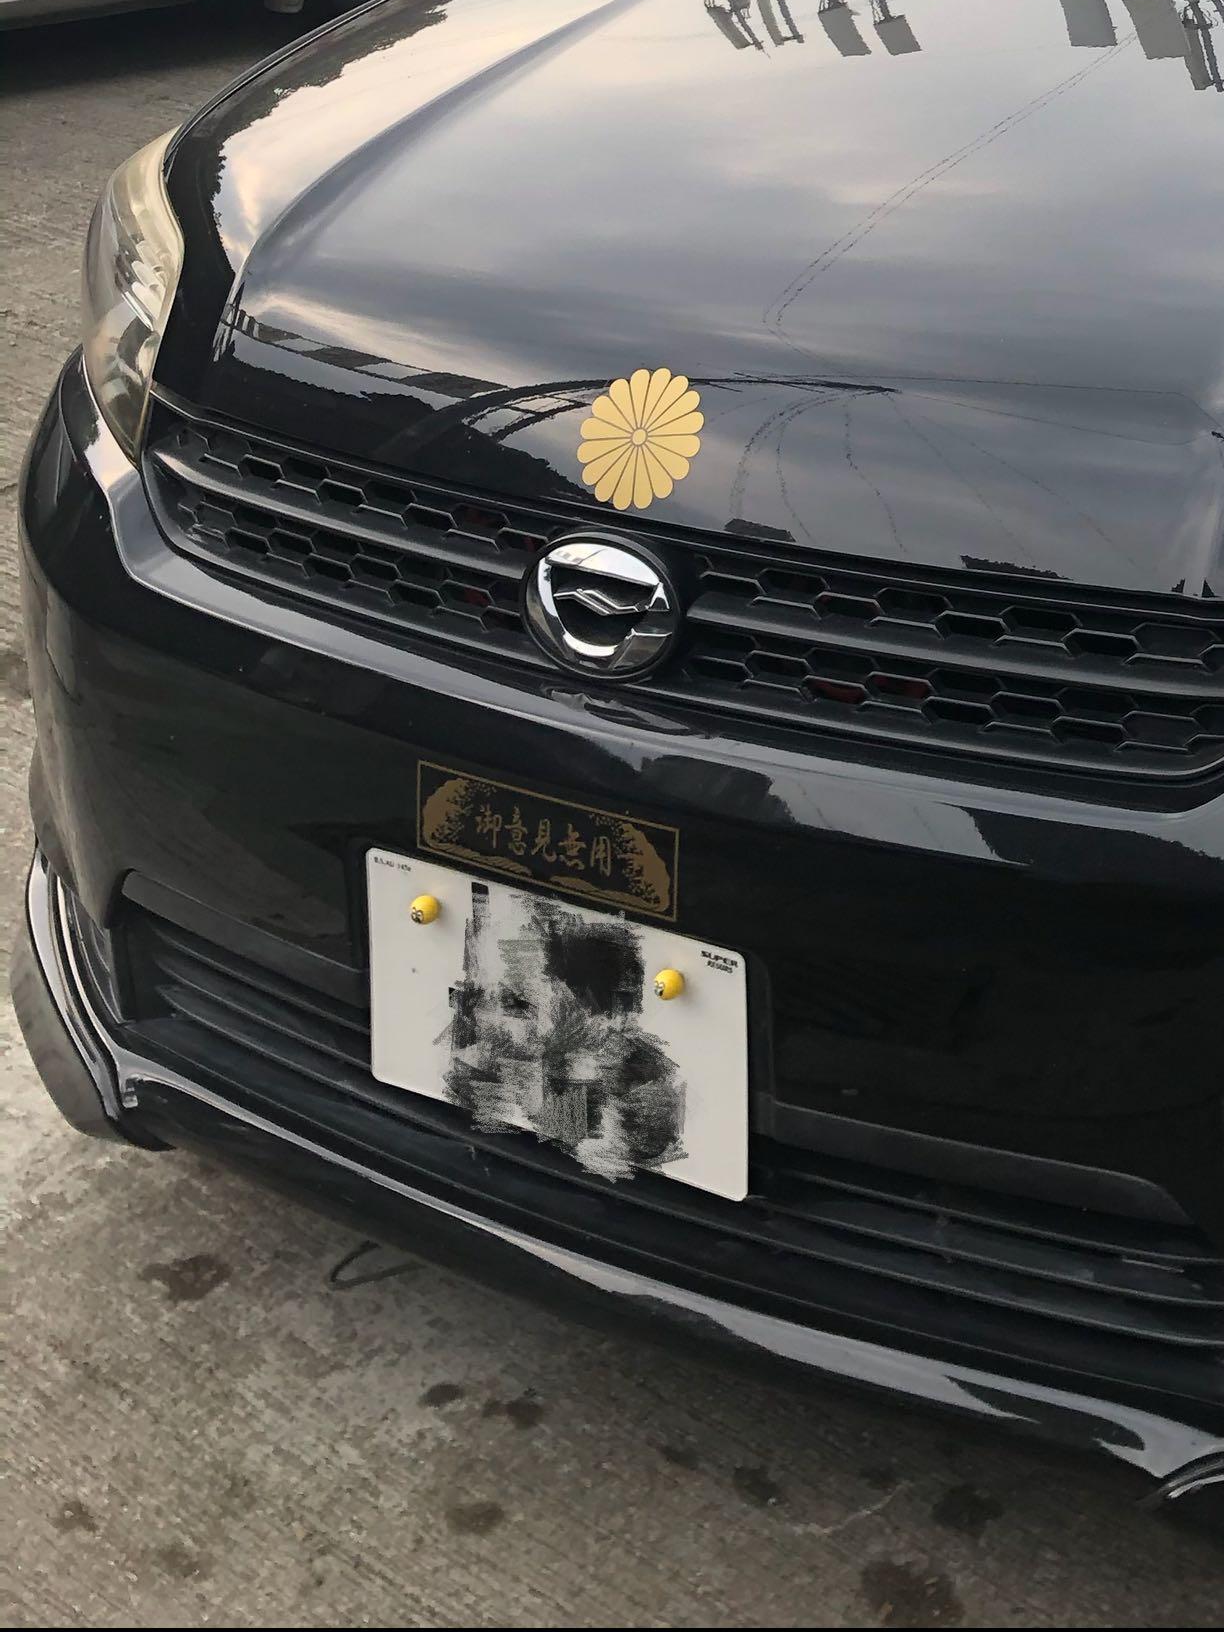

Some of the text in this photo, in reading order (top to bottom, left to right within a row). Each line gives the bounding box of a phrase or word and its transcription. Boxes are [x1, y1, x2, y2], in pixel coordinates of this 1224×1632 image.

[475, 803, 612, 877] 御意見無用
